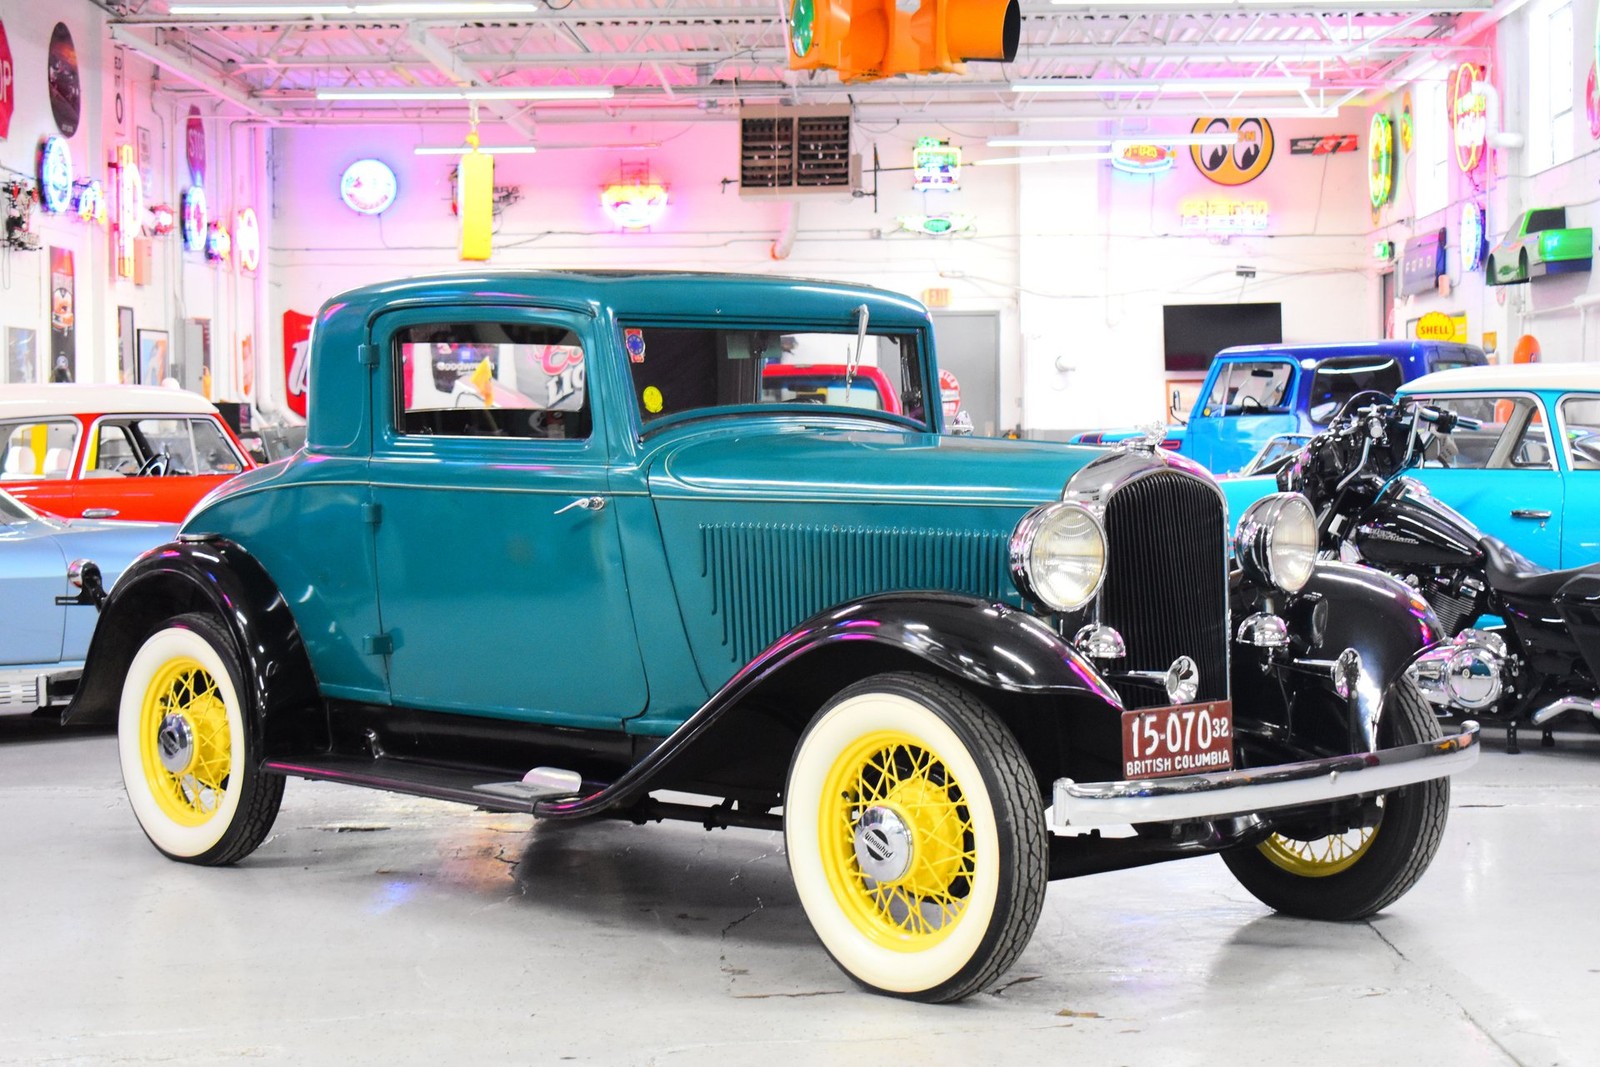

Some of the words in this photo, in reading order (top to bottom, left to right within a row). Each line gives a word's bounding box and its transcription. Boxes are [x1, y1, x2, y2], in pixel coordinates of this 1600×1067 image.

[928, 288, 949, 306] EXIT
[1420, 326, 1449, 335] SHELL
[1132, 709, 1212, 758] 15-070
[1212, 717, 1229, 738] 32
[1126, 757, 1171, 776] BRITISH
[1174, 749, 1230, 770] COLUMBIA
